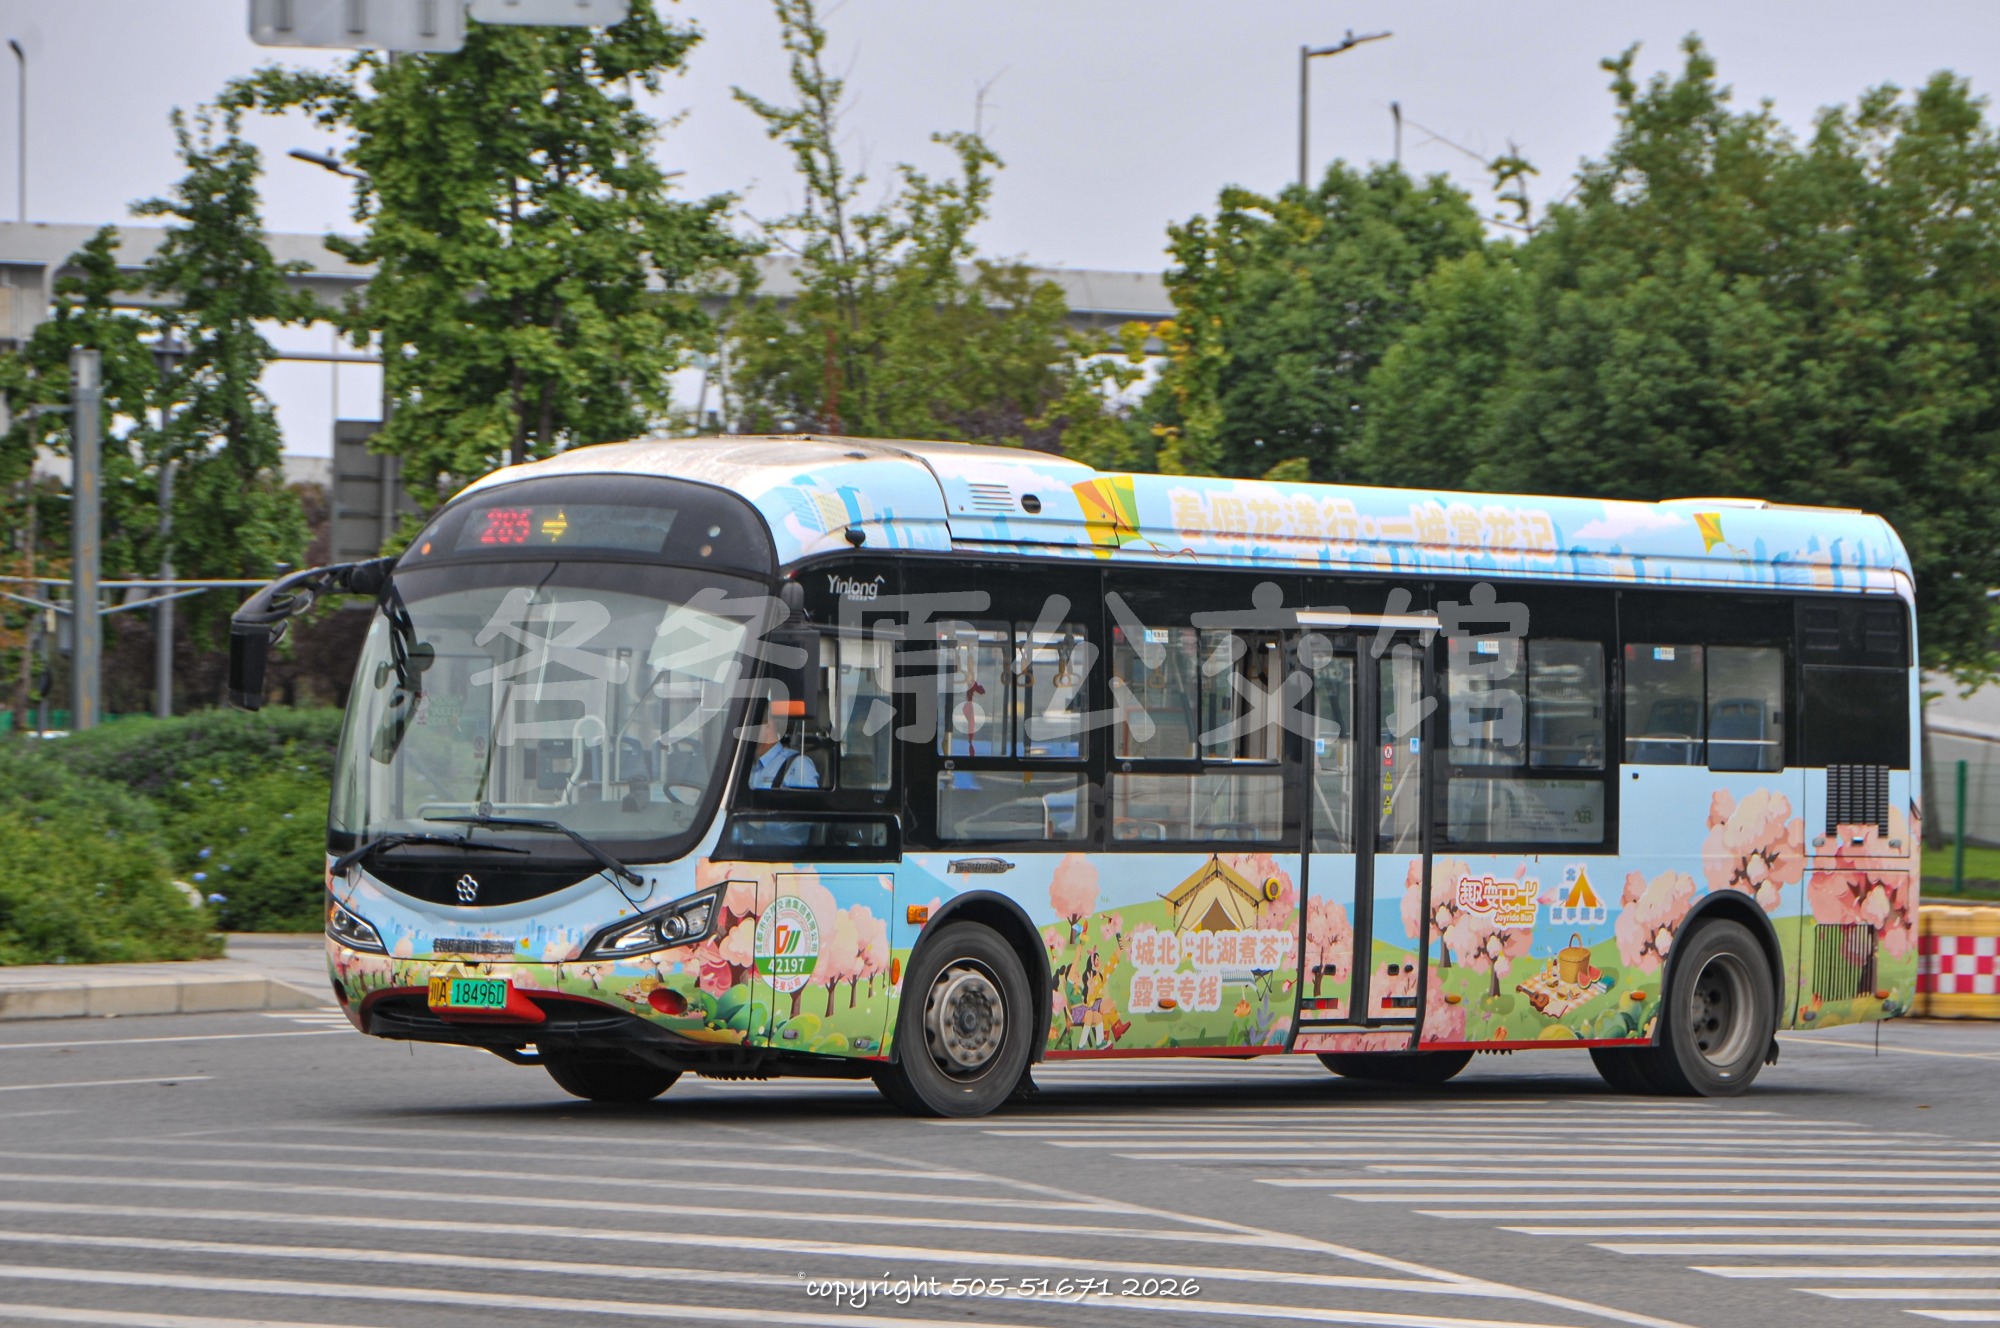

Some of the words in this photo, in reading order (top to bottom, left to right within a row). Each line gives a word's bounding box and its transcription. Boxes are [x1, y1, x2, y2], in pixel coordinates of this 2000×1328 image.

[827, 574, 878, 600] Yinlong
[1494, 912, 1520, 925] Joyride
[1521, 912, 1533, 923] Bus
[768, 957, 806, 973] 42197
[1131, 975, 1219, 1008] 露营专线
